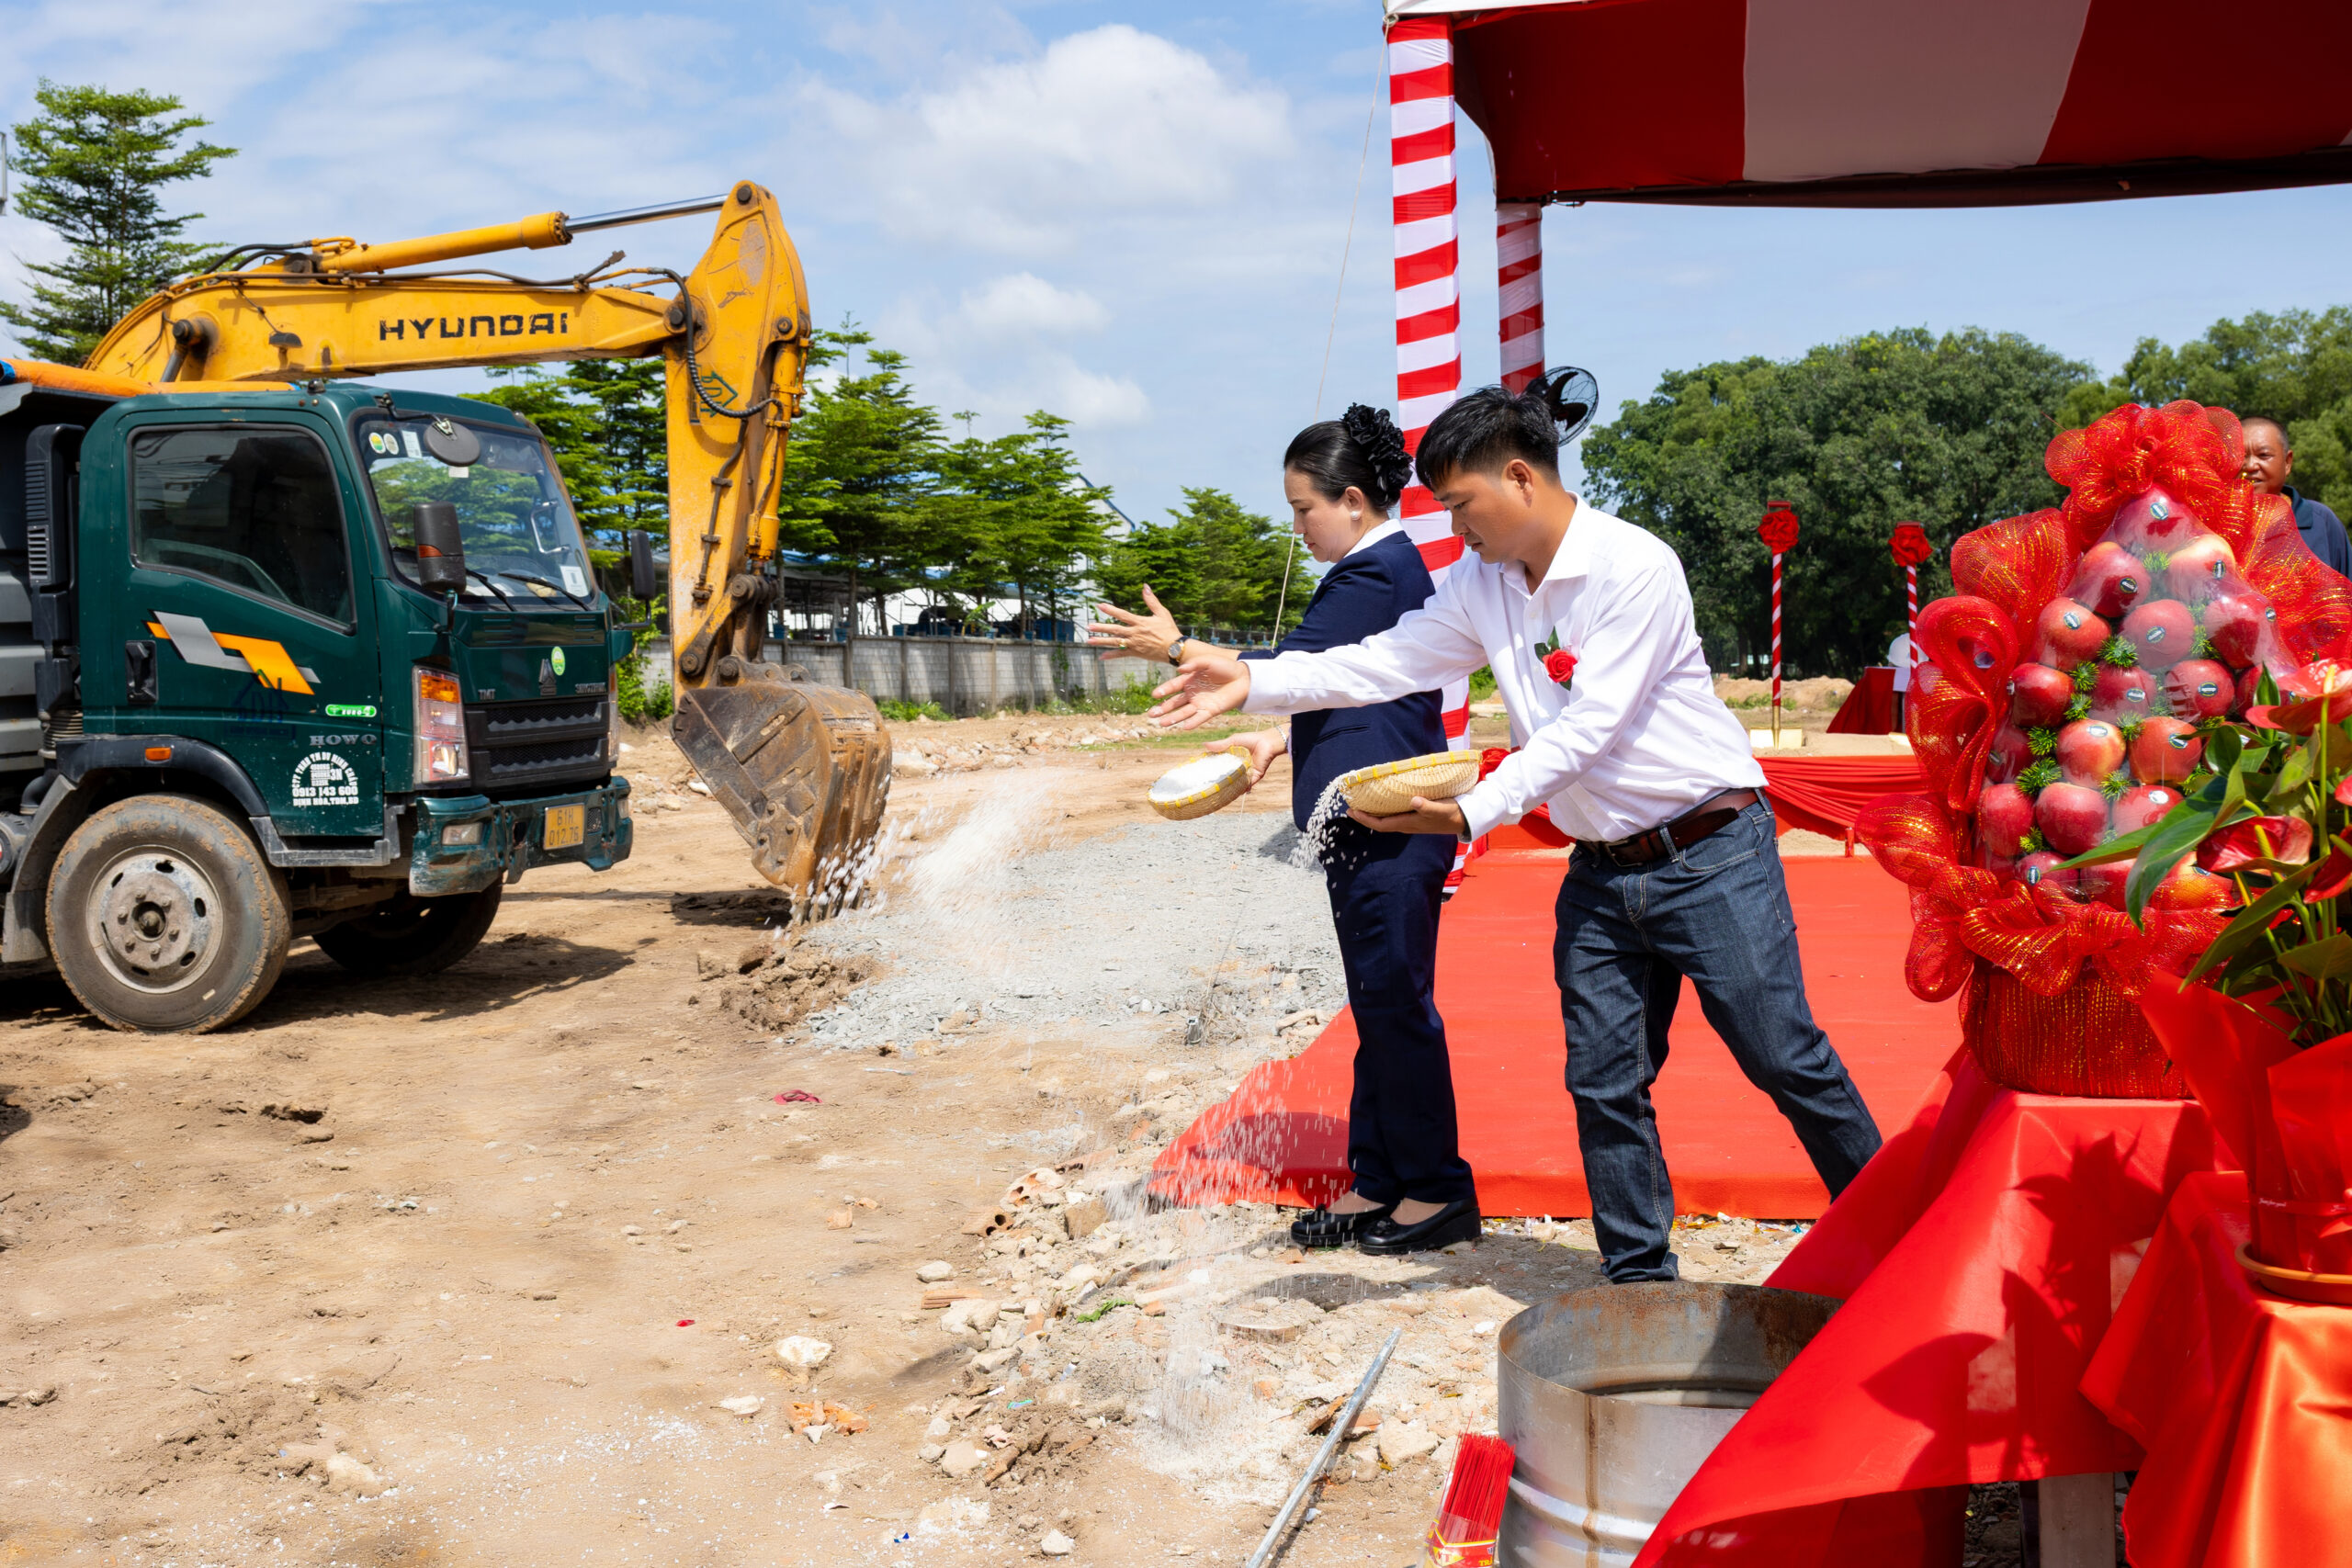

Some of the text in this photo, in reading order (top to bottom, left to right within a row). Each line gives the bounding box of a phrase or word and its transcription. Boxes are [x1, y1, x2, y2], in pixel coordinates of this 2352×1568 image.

[379, 312, 568, 341] HYUNDAI
[478, 689, 496, 700] TMT
[310, 734, 378, 746] HOWO
[292, 785, 358, 797] 0913 143 600
[557, 808, 574, 826] 61H
